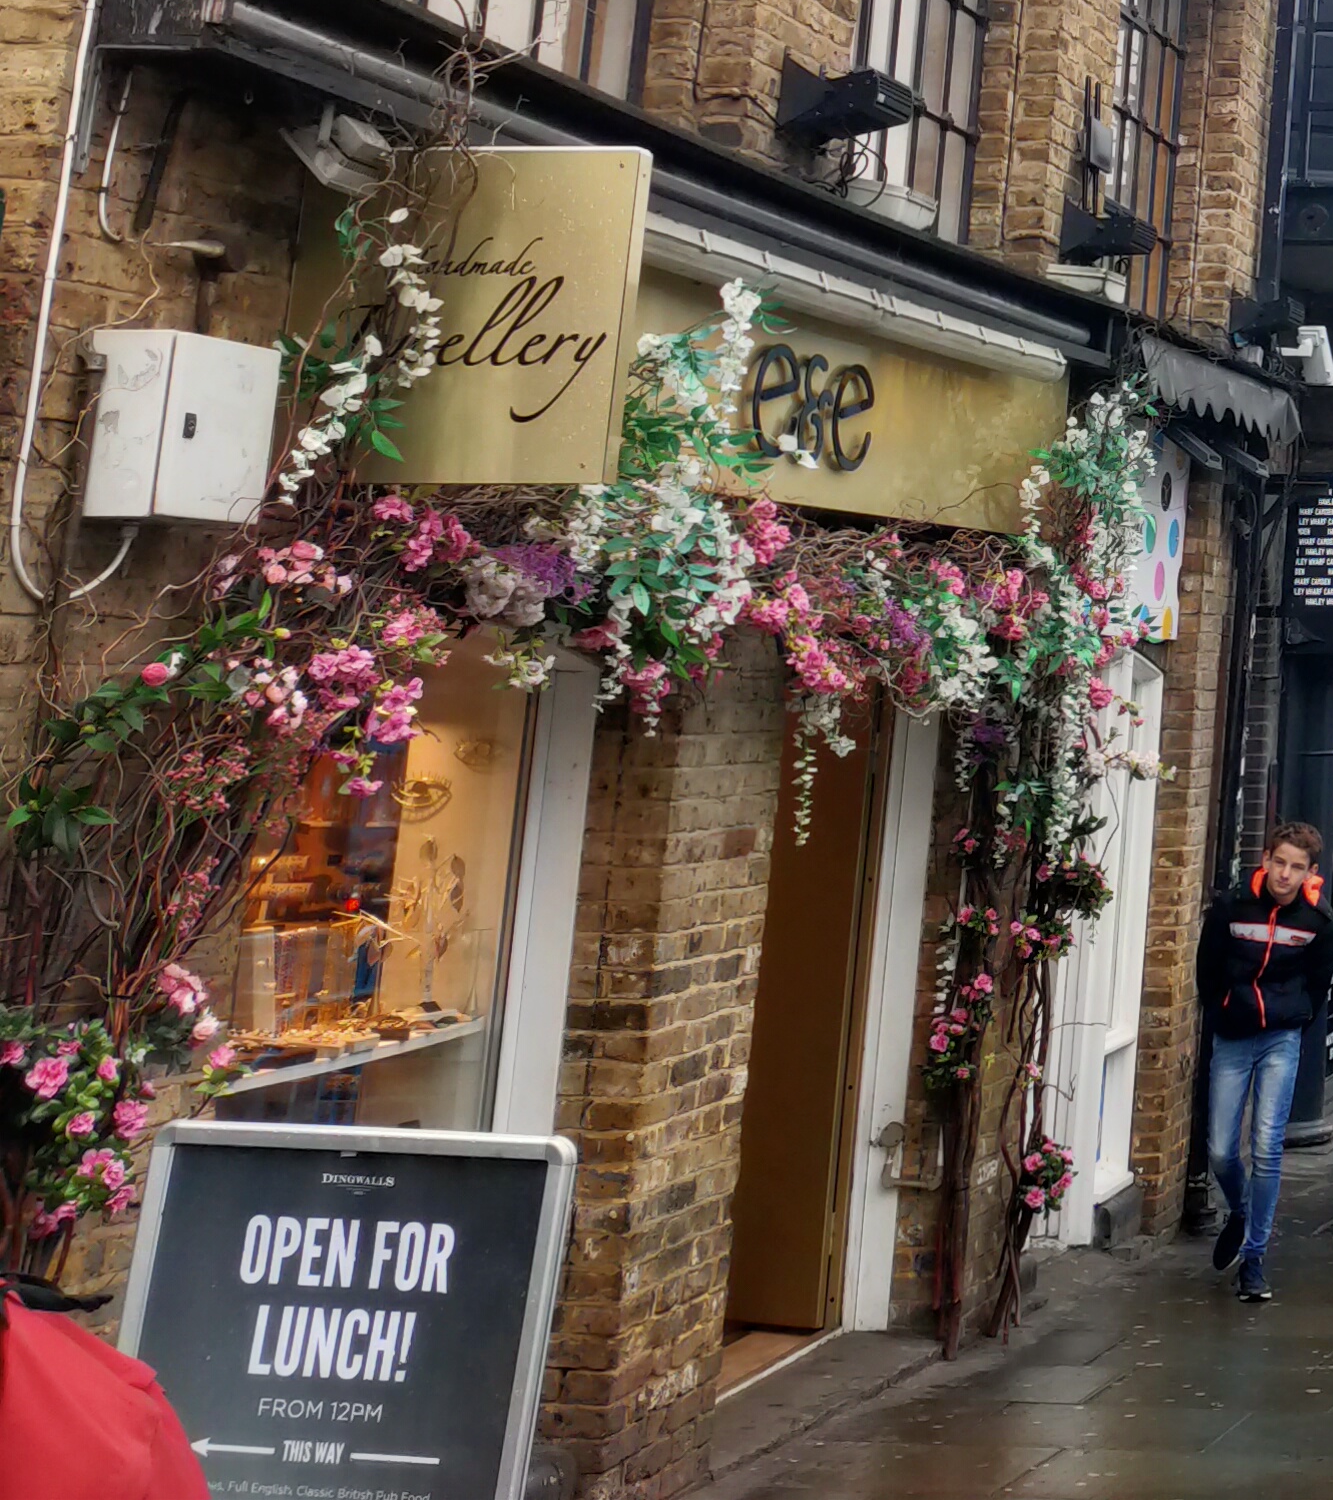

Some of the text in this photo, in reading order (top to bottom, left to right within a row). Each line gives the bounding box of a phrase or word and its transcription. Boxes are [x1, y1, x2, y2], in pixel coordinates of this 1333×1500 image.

[321, 1173, 395, 1187] DINGWALLS
[239, 1214, 455, 1294] OPEN FOR
[247, 1304, 417, 1382] LUNCH!
[257, 1398, 384, 1423] FROM 12PM
[282, 1440, 345, 1465] THIS WAY
[228, 1480, 248, 1493] Full
[296, 1485, 334, 1499] Classic
[337, 1487, 373, 1500] British
